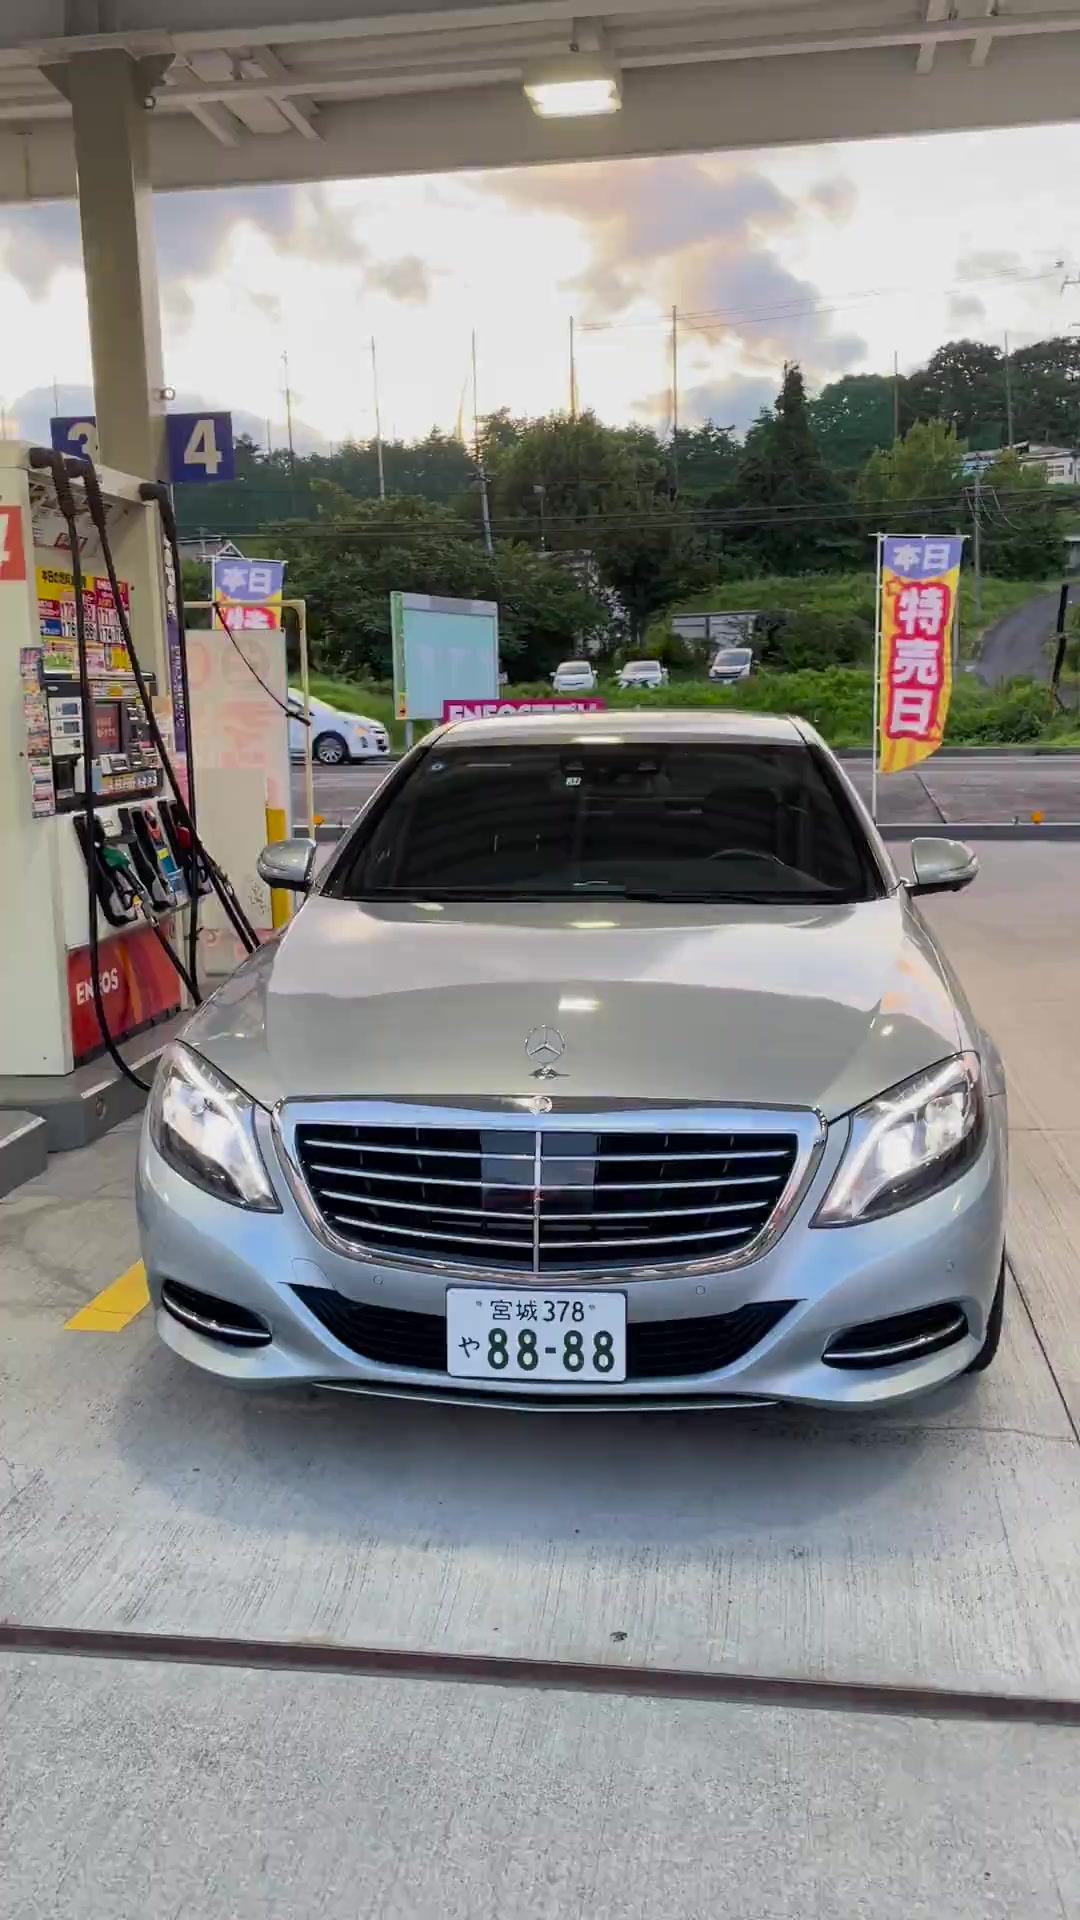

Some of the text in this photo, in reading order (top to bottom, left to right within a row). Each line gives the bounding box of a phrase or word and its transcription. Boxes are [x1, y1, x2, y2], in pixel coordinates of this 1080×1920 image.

[184, 420, 222, 474] 4
[893, 544, 950, 571] 本日
[221, 566, 272, 594] 本日
[891, 587, 945, 736] 特売日
[76, 968, 119, 1006] ENOS
[458, 1327, 615, 1373] や 88-88
